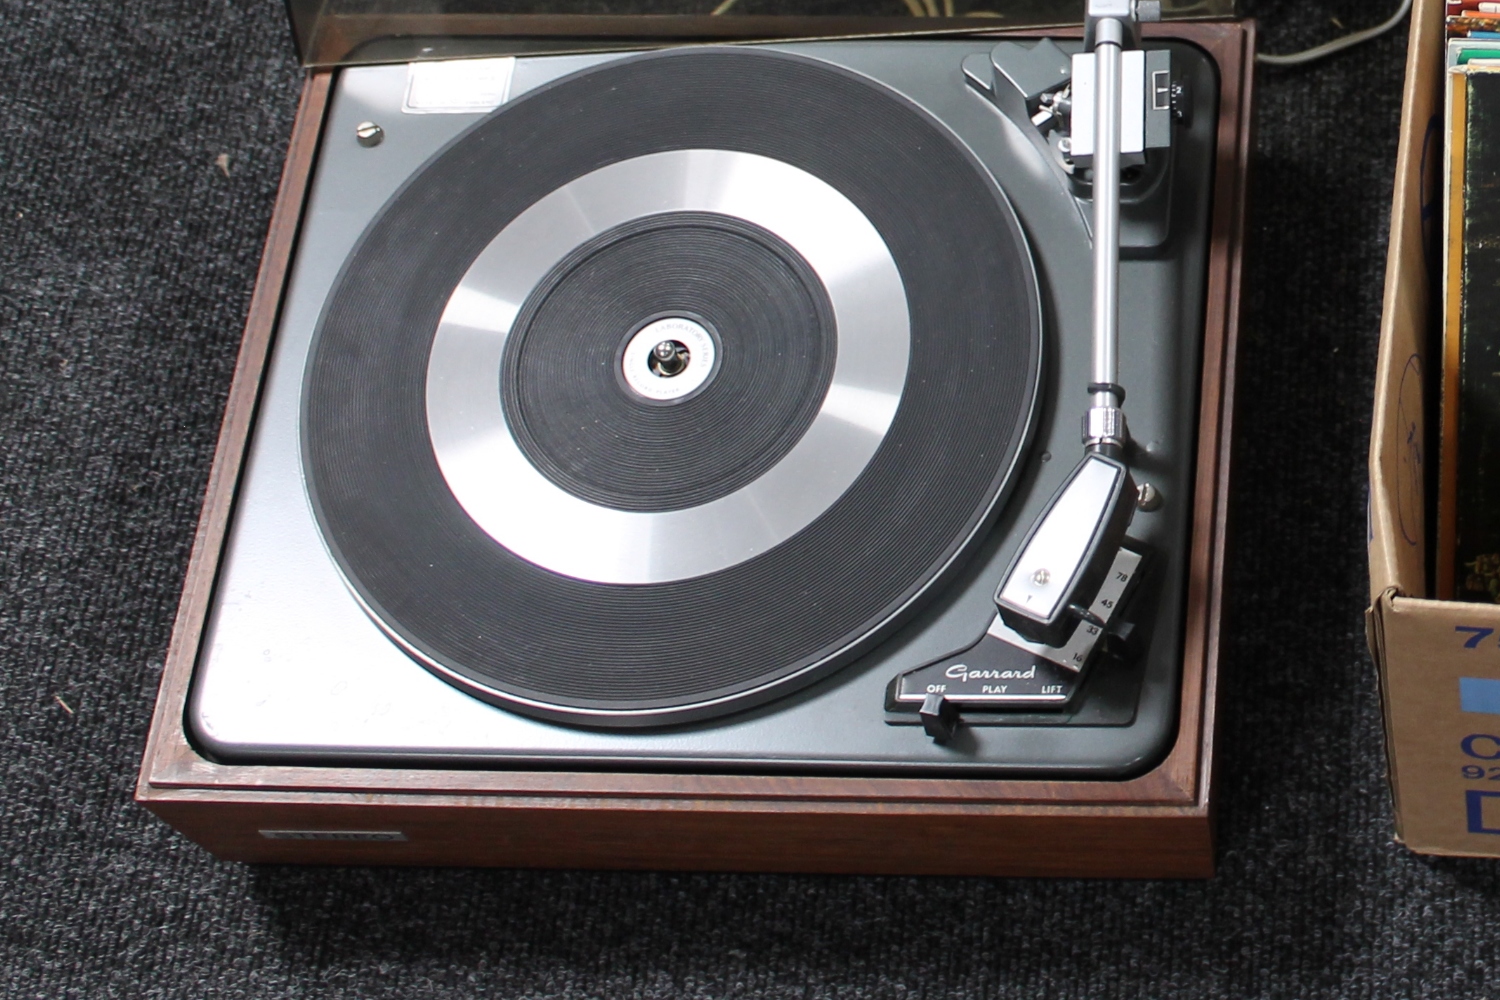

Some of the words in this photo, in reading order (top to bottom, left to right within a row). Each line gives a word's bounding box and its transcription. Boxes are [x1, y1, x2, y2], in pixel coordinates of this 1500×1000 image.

[1114, 570, 1128, 583] 78
[1100, 598, 1114, 610] 45
[1085, 624, 1101, 637] 33
[1072, 651, 1084, 663] 16
[944, 663, 1038, 683] Garrard
[926, 683, 947, 695] OFF
[981, 684, 1009, 695] PLAY
[1040, 684, 1064, 695] LIFT
